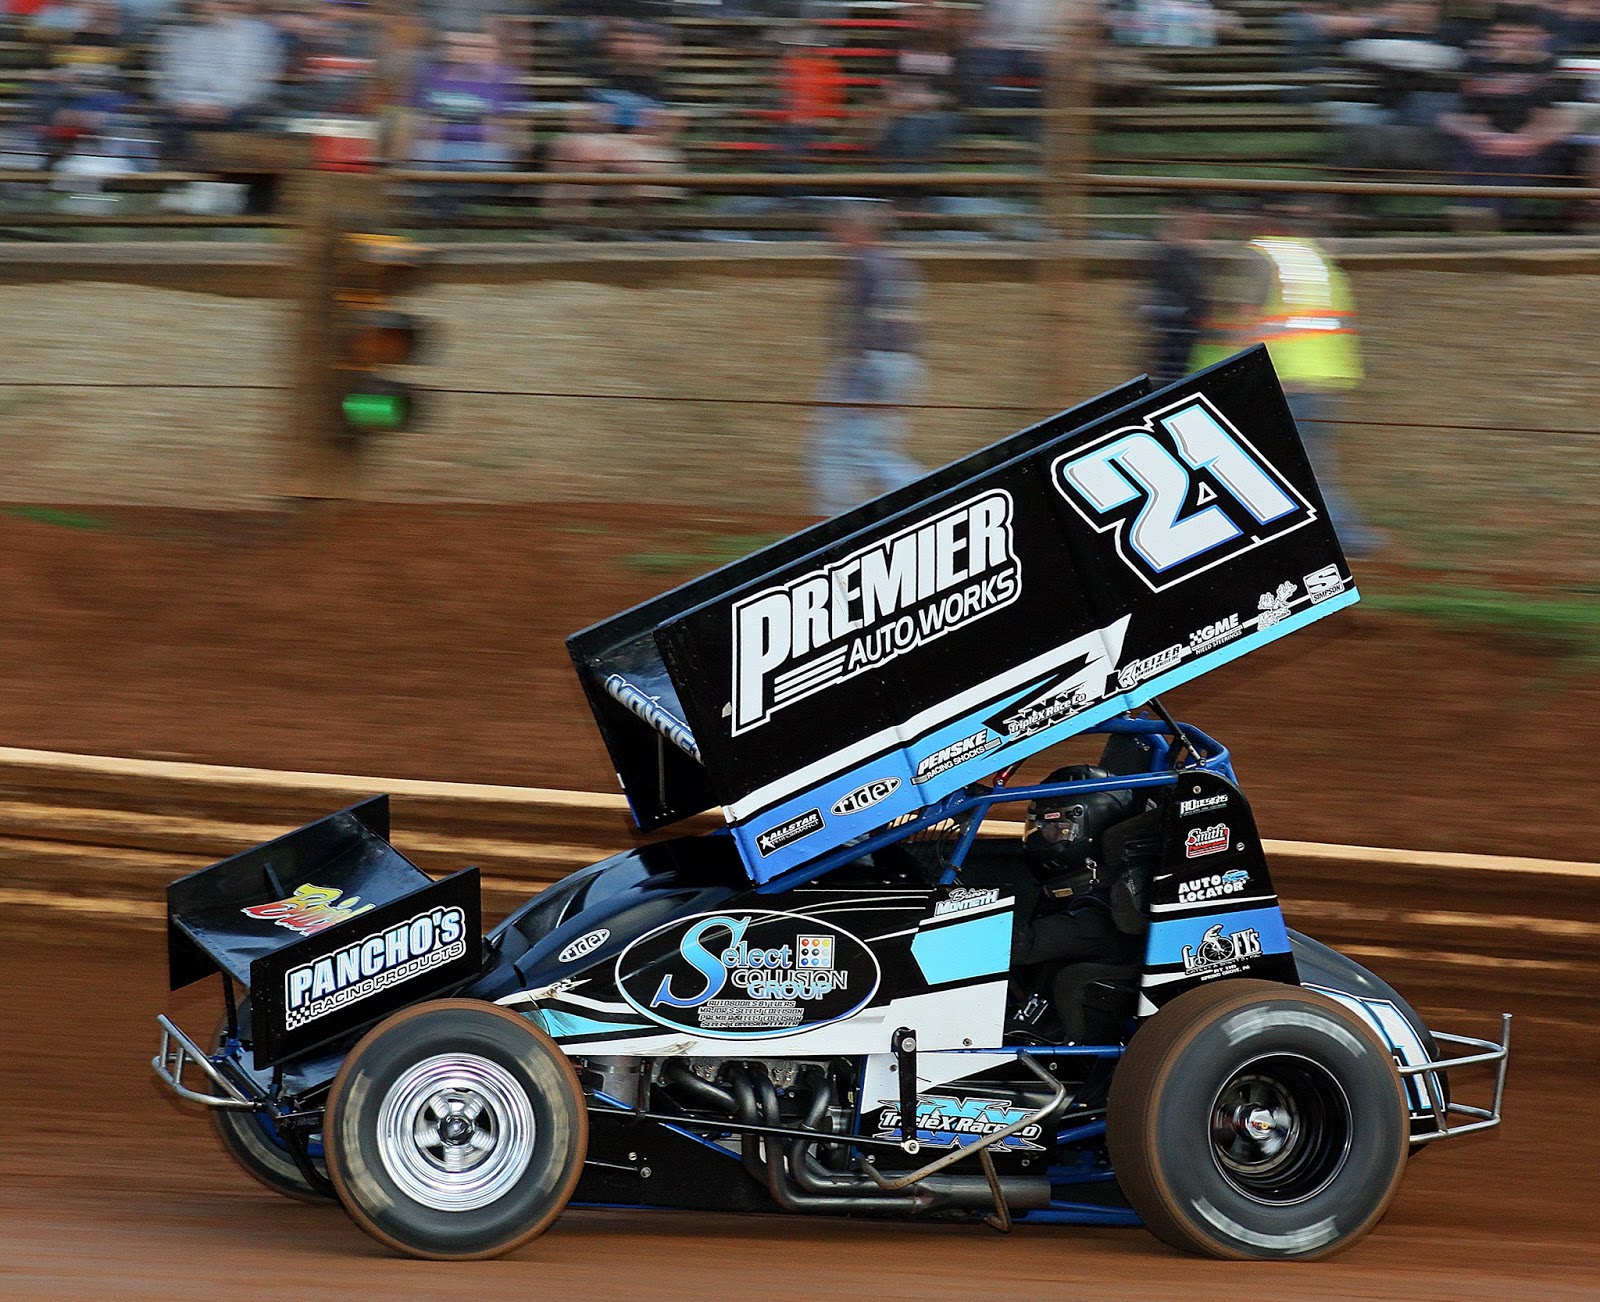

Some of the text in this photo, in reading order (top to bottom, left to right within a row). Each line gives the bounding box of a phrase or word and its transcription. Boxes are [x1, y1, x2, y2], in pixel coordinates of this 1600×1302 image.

[1062, 402, 1302, 575] 21
[1313, 584, 1341, 601] SIMPSON
[739, 495, 1008, 726] PREMIER
[847, 567, 1015, 670] AUTO WORKS
[1201, 612, 1239, 640] GME
[1135, 646, 1181, 674] KEIZER
[917, 728, 988, 776] PENSKE
[926, 746, 986, 780] RACING SHOCKS
[837, 779, 899, 814] rider
[768, 812, 818, 839] ALLSTAR
[1186, 823, 1226, 845] Smith
[1178, 874, 1222, 894] AUTO
[1178, 881, 1245, 904] LOCATOR
[561, 931, 608, 961] rider
[650, 916, 793, 1008] Select
[311, 943, 464, 1015] RACING PRODUCTS
[731, 969, 848, 990] COLLISION
[747, 980, 833, 1000] GROUP
